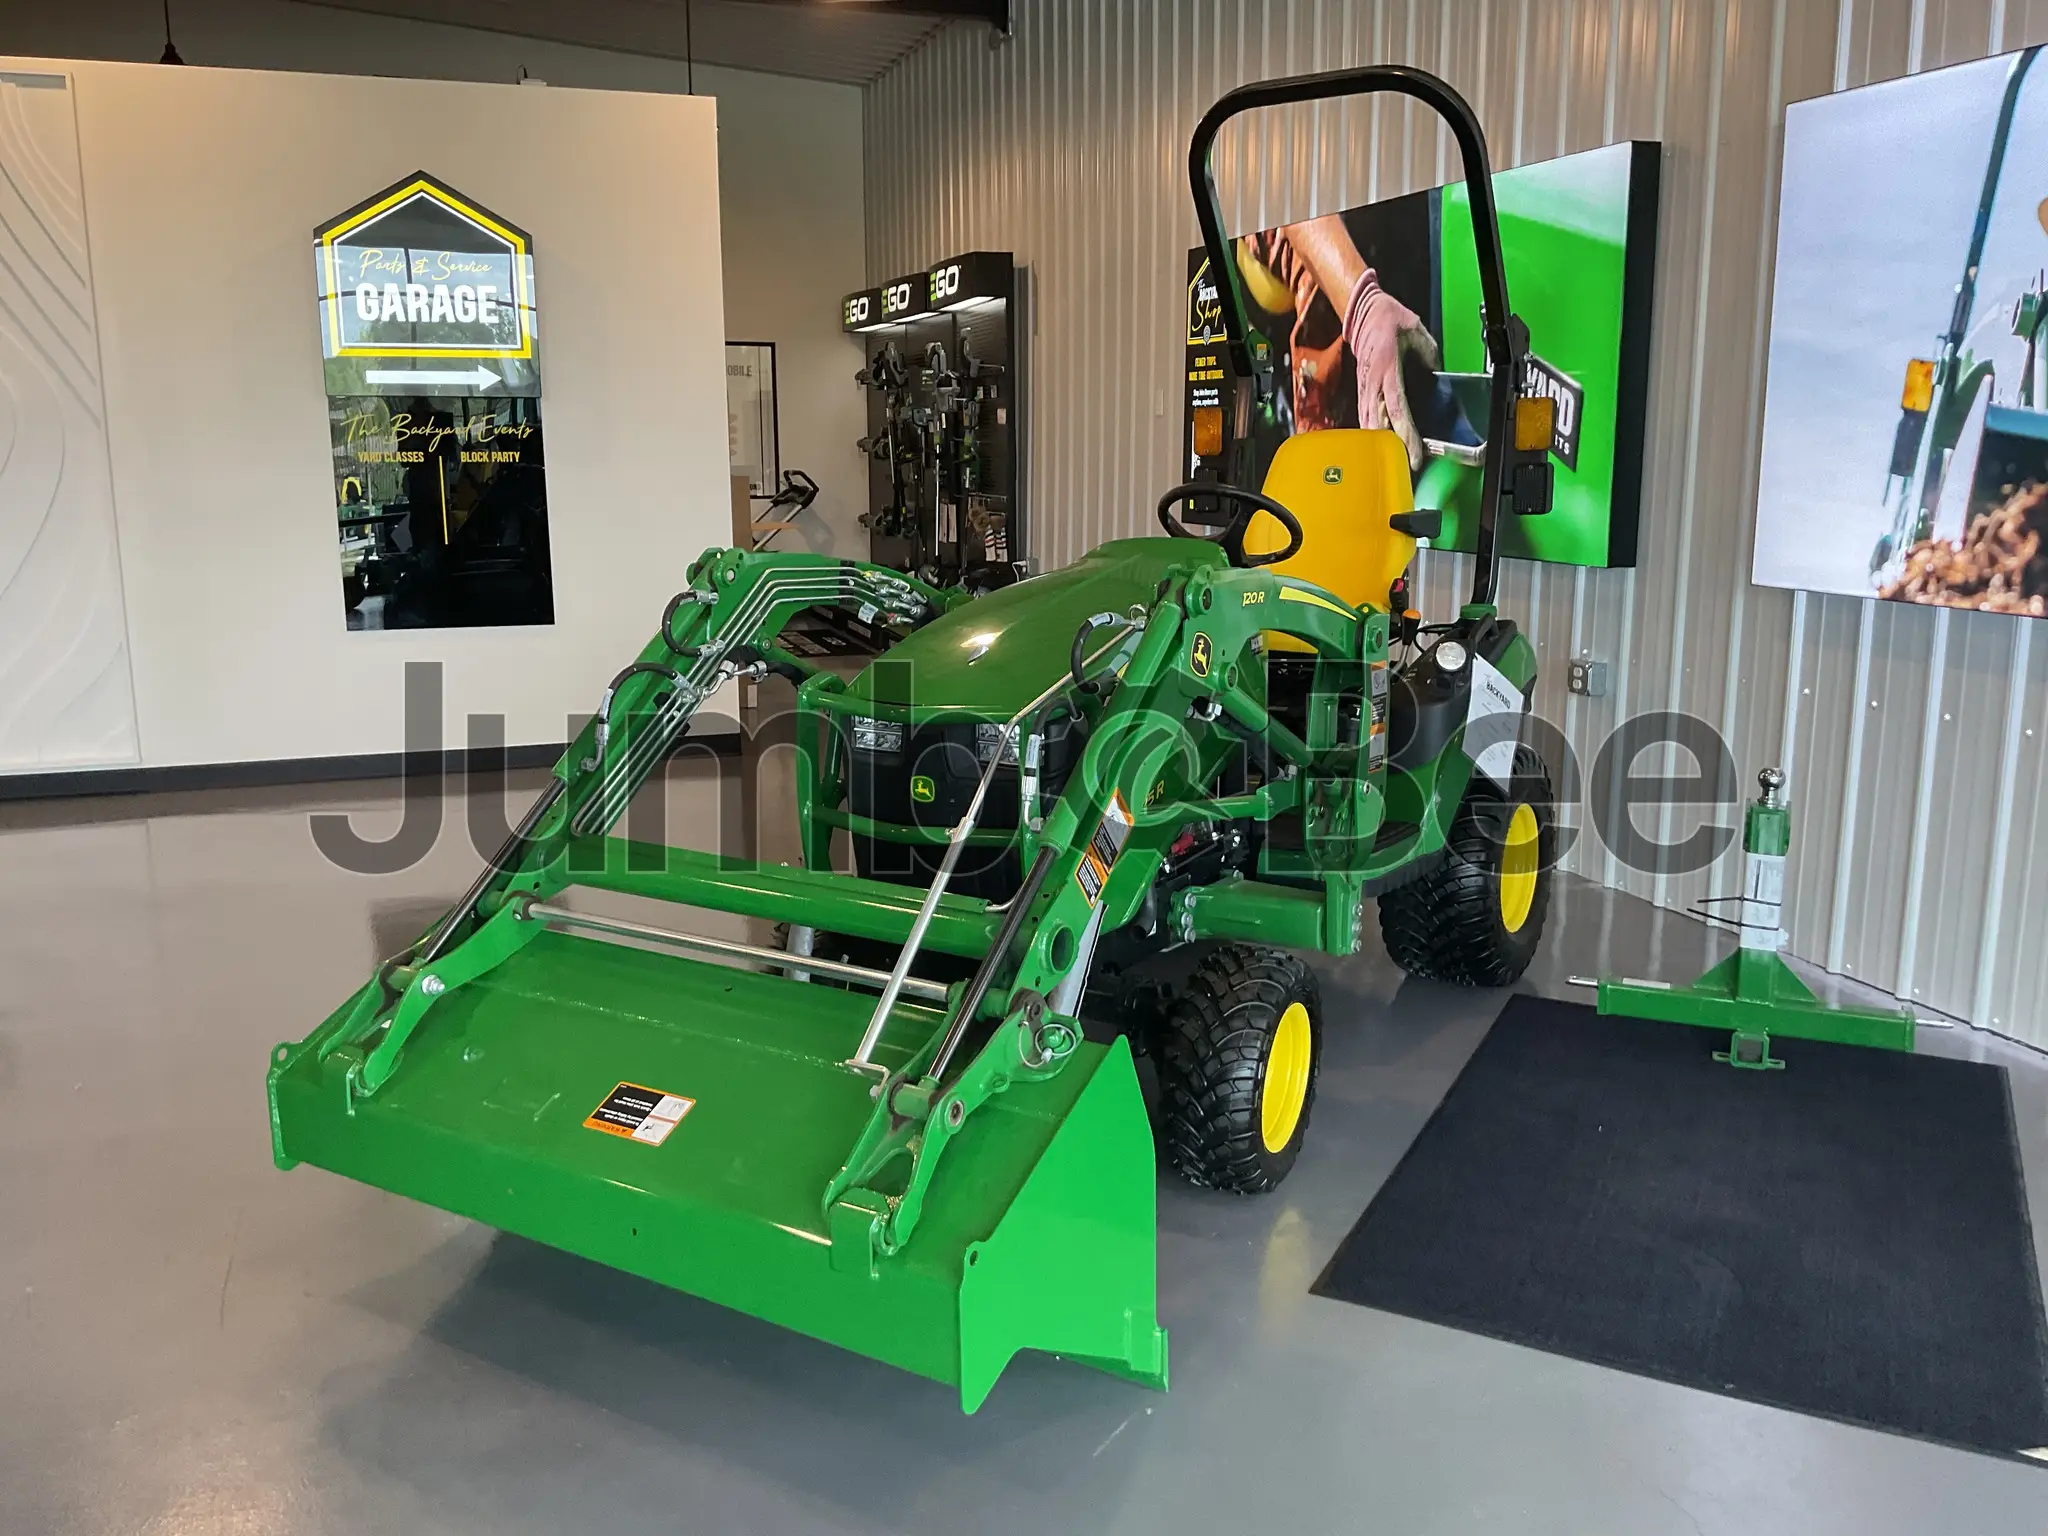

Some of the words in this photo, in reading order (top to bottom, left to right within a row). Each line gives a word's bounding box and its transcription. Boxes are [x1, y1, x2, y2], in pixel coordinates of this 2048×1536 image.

[359, 249, 405, 278] Parts
[432, 251, 493, 280] Service
[355, 282, 500, 324] GARAGE
[340, 414, 383, 443] The
[382, 413, 475, 453] Backyard
[477, 413, 534, 443] Events
[384, 451, 425, 463] CLASSES
[460, 452, 489, 463] BLOCK
[491, 451, 520, 463] PARTY
